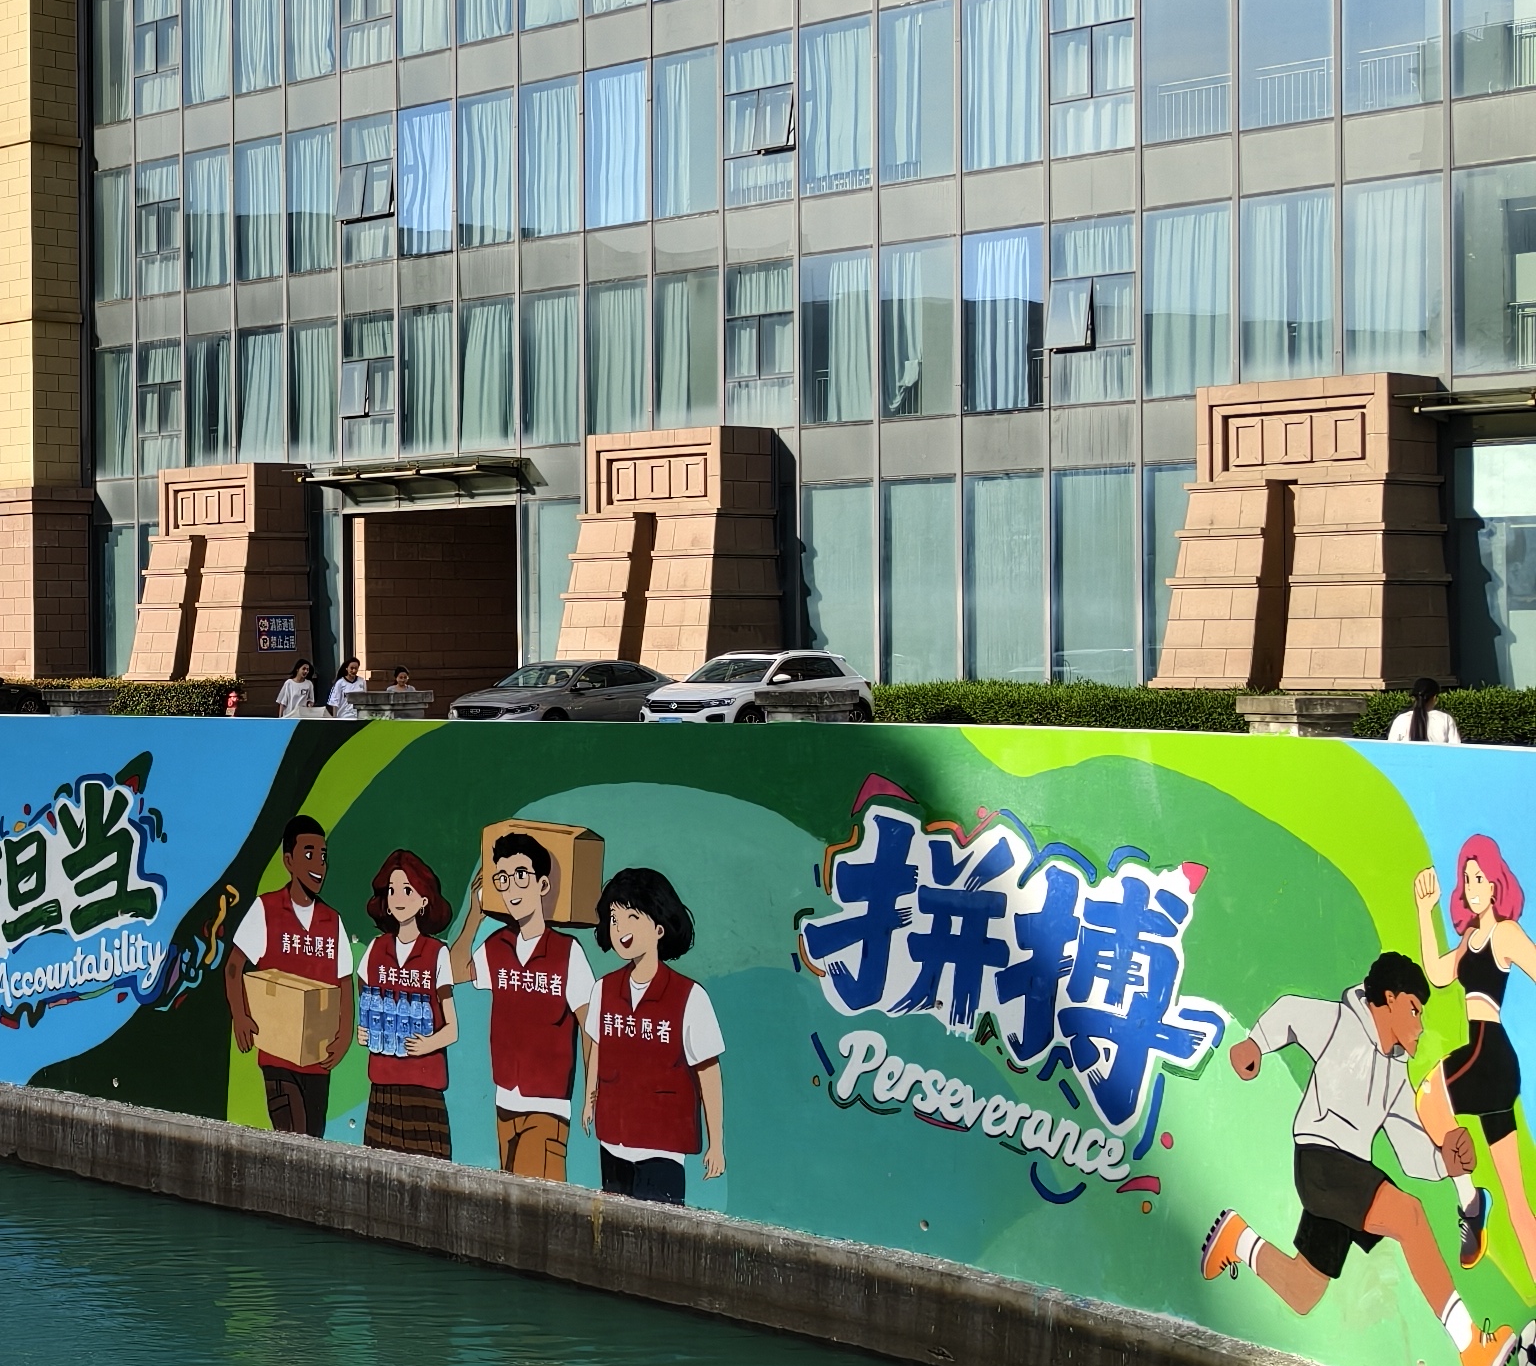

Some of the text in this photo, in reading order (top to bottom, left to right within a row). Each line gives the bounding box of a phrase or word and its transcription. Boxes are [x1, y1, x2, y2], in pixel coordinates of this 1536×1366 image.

[281, 932, 336, 960] 青年志愿者
[377, 965, 432, 990] 青年志愿者
[497, 967, 563, 997] 青年志愿者
[803, 813, 1207, 1127] 拼搏
[602, 1012, 672, 1044] 青年志愿者
[836, 1029, 1131, 1181] Perseverance
